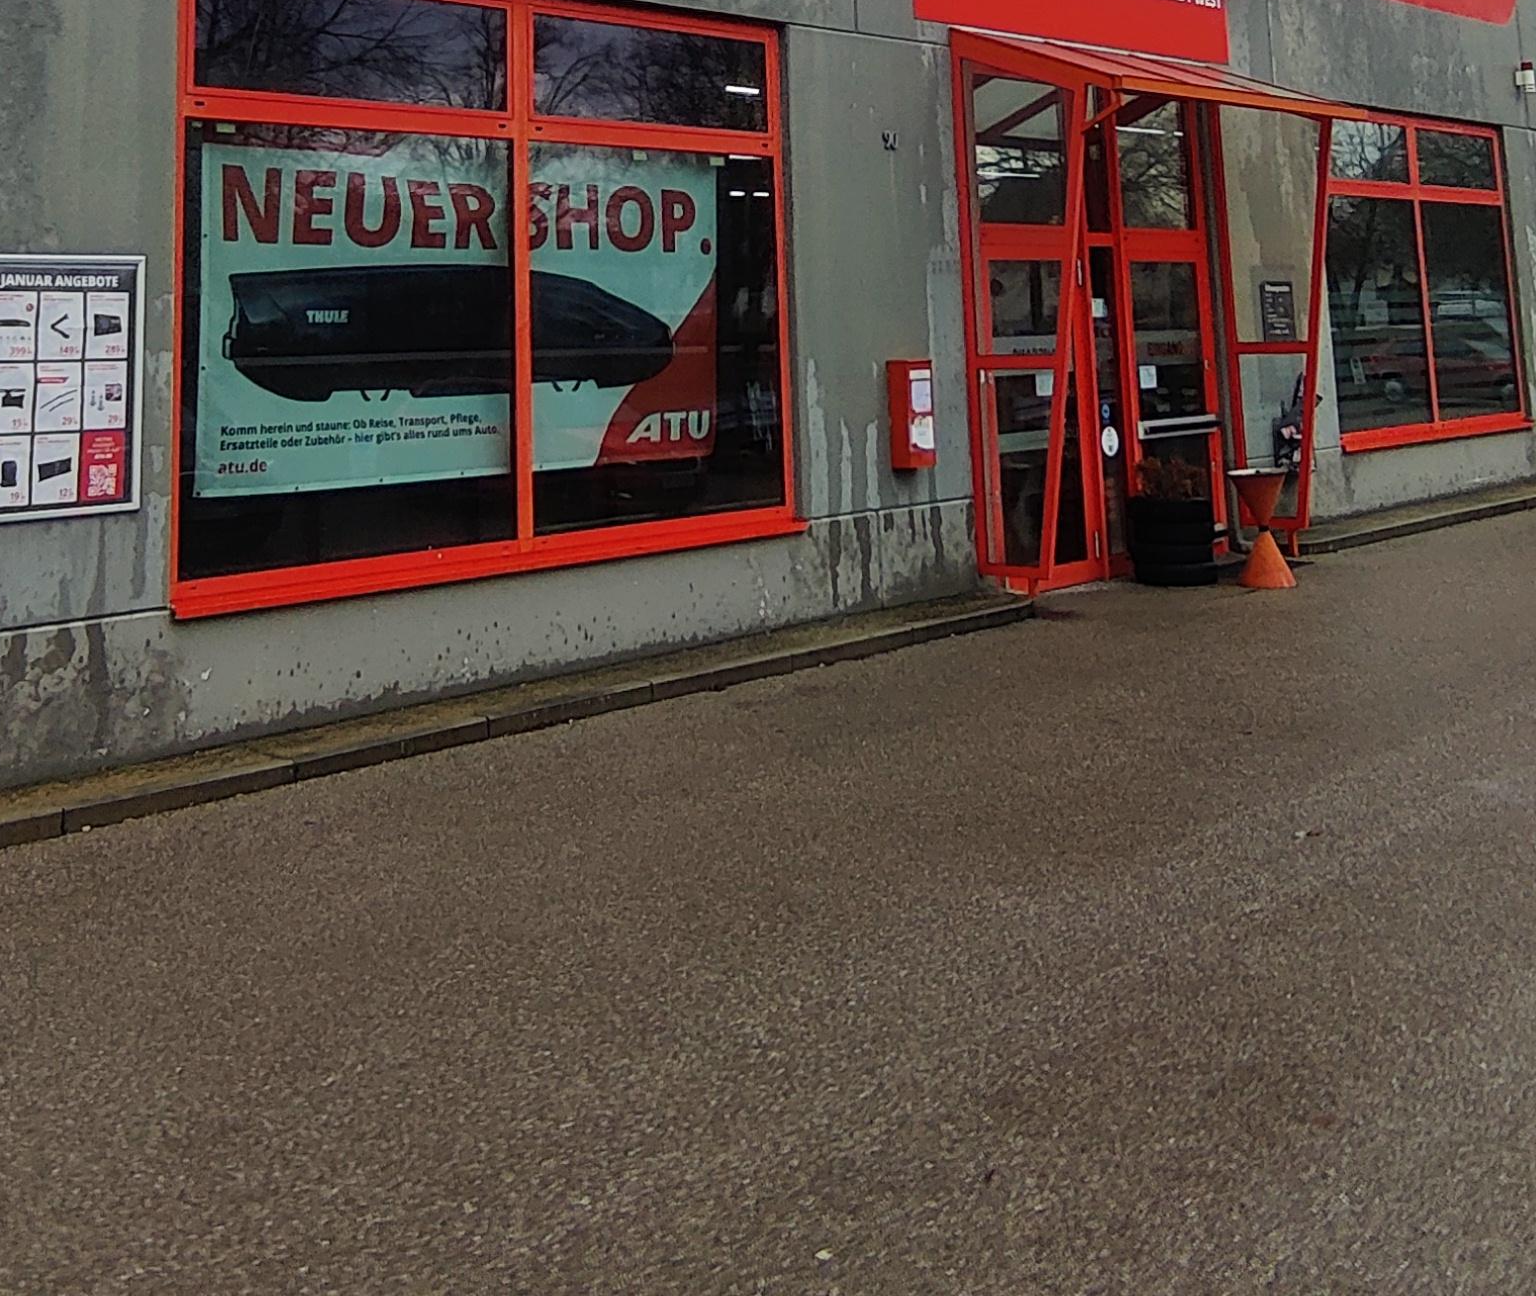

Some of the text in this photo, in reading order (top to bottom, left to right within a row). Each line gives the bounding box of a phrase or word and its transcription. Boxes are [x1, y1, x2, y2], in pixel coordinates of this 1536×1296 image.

[221, 163, 713, 255] NEUER SHOP.
[0, 273, 120, 288] JANUAR ANGEBOTE
[305, 309, 350, 323] THULE
[221, 426, 257, 436] Komm
[260, 422, 293, 434] herein
[295, 421, 314, 432] und
[353, 418, 367, 429] Ob
[450, 412, 482, 425] Pflege,
[626, 410, 710, 443] ATU
[220, 437, 278, 451] Ersatzteile
[280, 436, 303, 448] oder
[305, 434, 346, 447] Zubehör
[354, 432, 373, 443] hier
[403, 428, 426, 440] alles
[427, 427, 450, 438] rund
[452, 427, 473, 437] ums
[217, 459, 268, 474] atu.de
